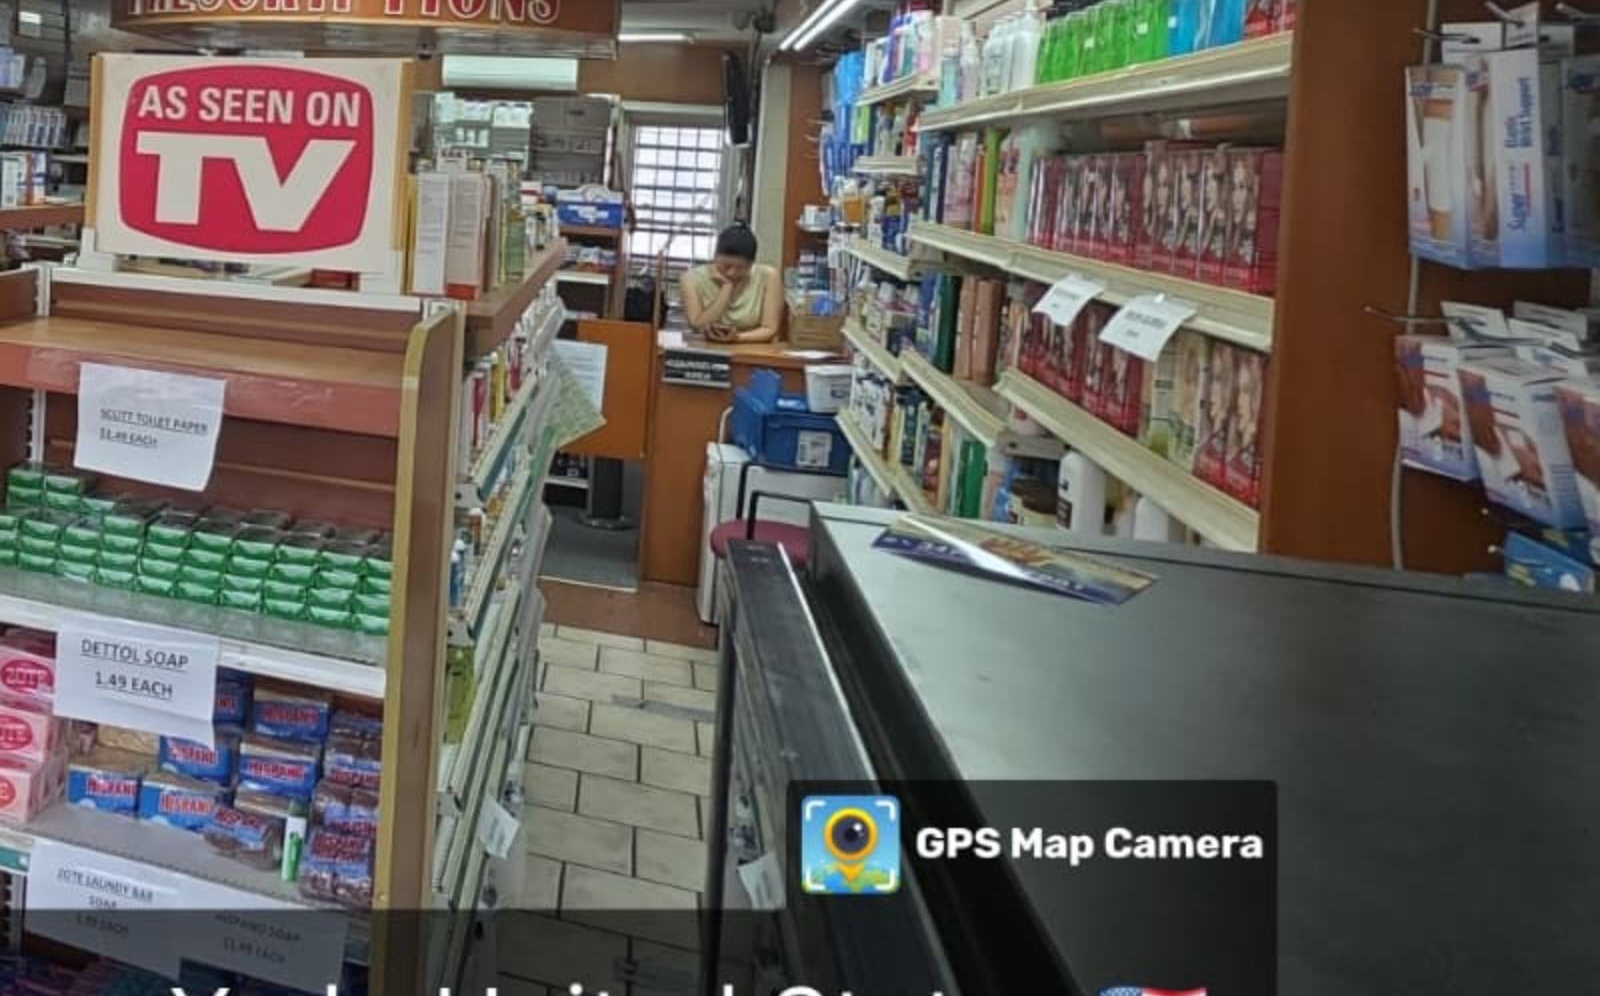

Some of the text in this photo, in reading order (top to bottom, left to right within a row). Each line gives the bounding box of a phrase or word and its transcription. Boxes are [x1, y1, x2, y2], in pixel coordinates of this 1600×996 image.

[137, 85, 361, 128] AS SEEN ON
[135, 130, 359, 233] TV
[129, 434, 158, 447] EACH
[173, 418, 209, 434] PAPER
[81, 638, 189, 670] DETTOL SOAP
[95, 671, 174, 697] 1.49 EACH
